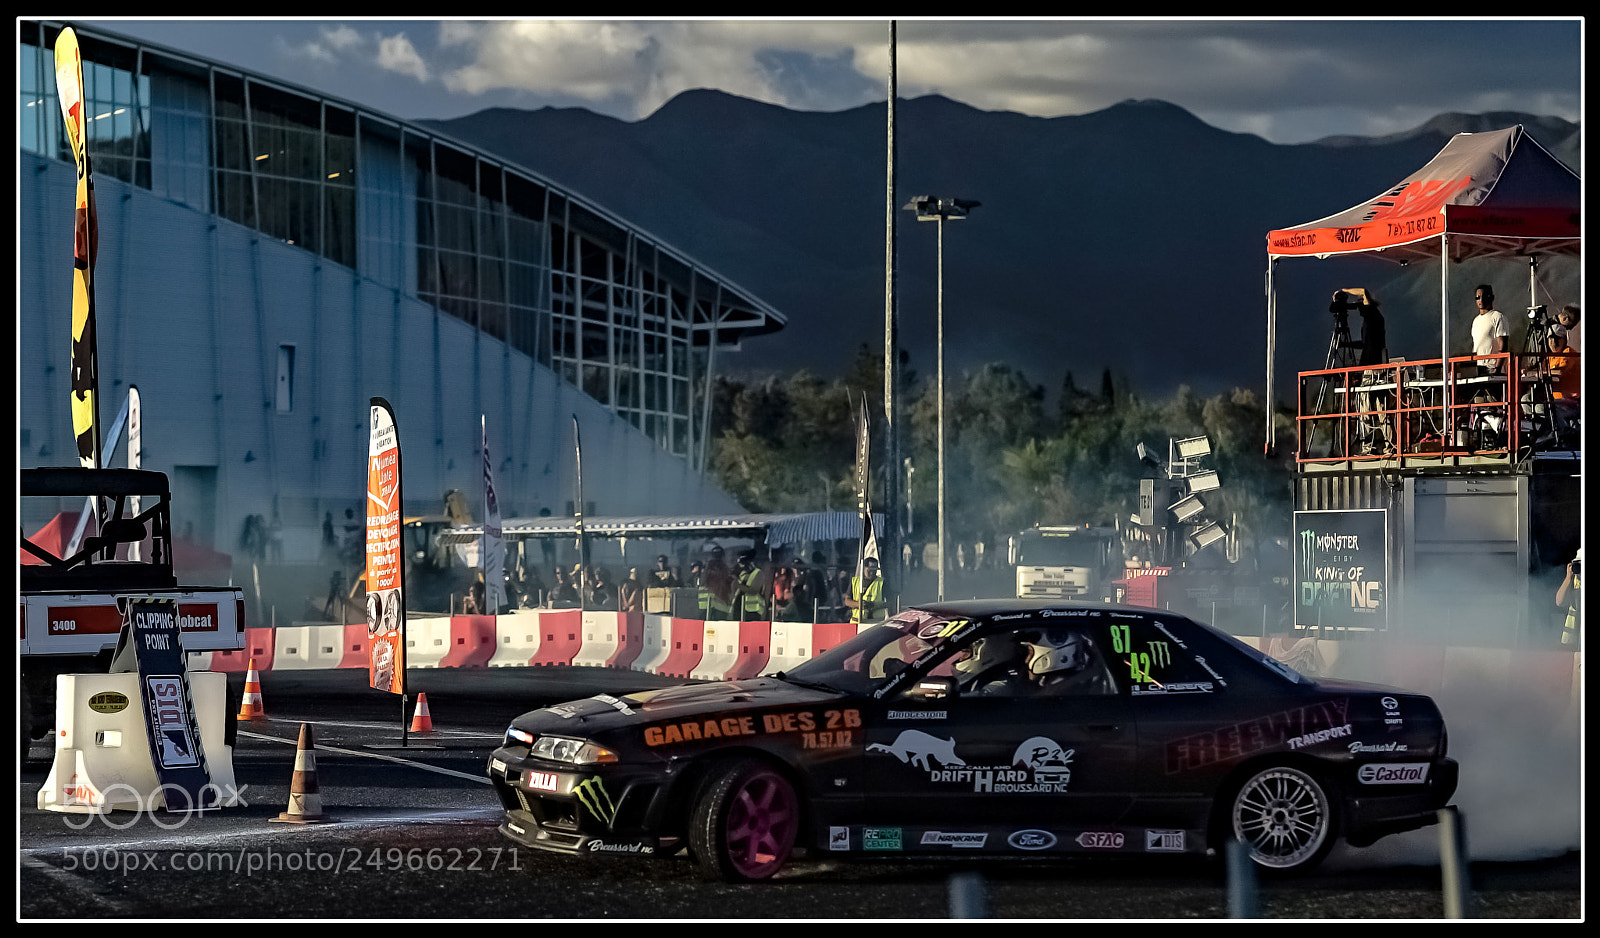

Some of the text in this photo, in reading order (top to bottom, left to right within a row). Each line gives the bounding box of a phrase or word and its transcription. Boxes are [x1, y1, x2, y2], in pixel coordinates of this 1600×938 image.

[1417, 219, 1425, 232] 87
[1427, 217, 1436, 230] 87
[1273, 233, 1317, 248] www.sfac.nc
[1317, 532, 1359, 552] MONSTER
[1347, 567, 1364, 581] OF
[53, 620, 76, 631] 3400
[136, 612, 174, 629] CLIPPING
[145, 634, 170, 650] POINT
[1110, 625, 1130, 653] 87
[1131, 652, 1150, 683] 42
[156, 683, 182, 725] DIS
[644, 709, 862, 747] GARAGE DES 2B
[1165, 698, 1349, 776] FREEWAY
[1288, 724, 1352, 750] TRANSPORT
[1031, 747, 1075, 767] R32
[931, 771, 973, 782] DRIFT
[1376, 767, 1423, 780] Castrol
[529, 772, 557, 791] ZILLA
[994, 784, 1067, 793] BROUSSARD NC
[864, 829, 900, 839] REPRO
[1019, 833, 1045, 845] Ford
[1088, 833, 1122, 846] SFAC
[1164, 834, 1182, 847] DIS
[588, 839, 642, 852] Broussard
[865, 840, 900, 849] CENTER
